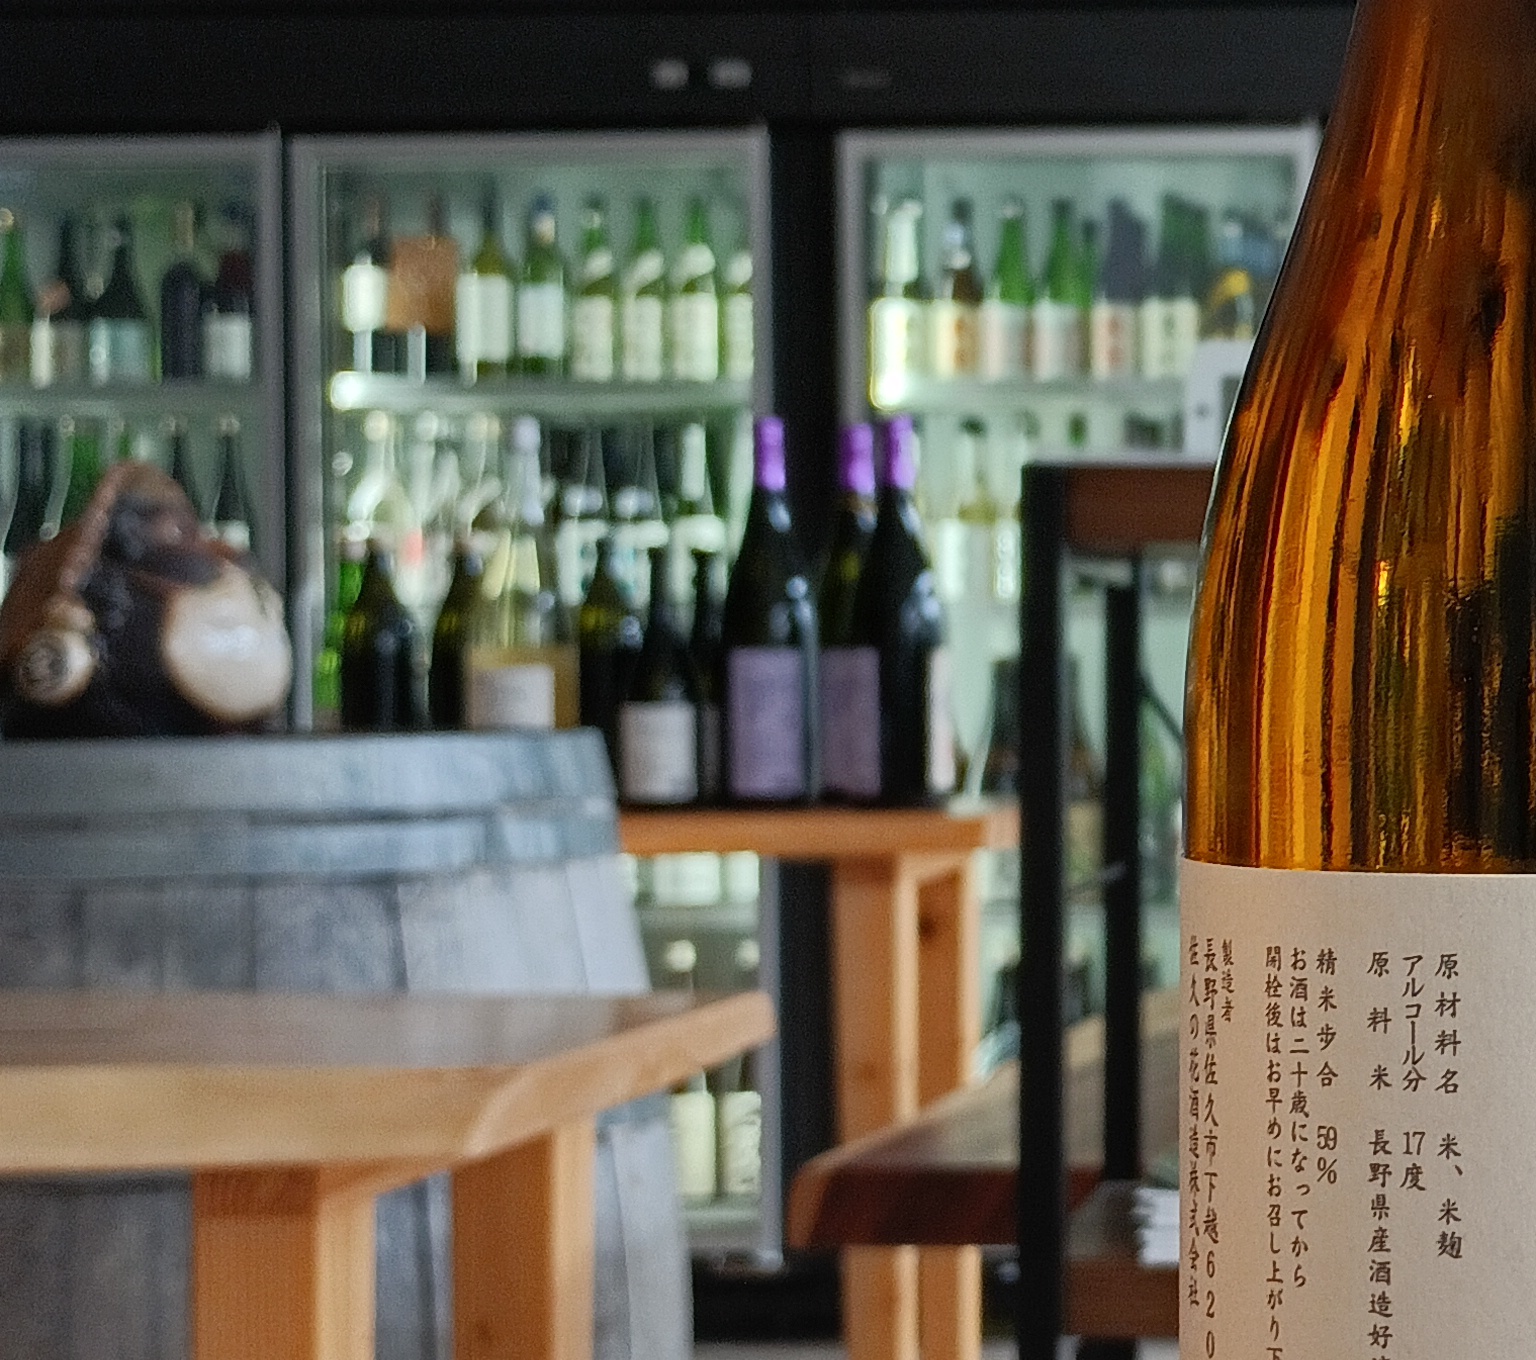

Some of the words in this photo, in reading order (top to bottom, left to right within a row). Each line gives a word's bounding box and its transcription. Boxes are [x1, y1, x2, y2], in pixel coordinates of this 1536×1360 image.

[1221, 939, 1235, 1023] 製造者
[1315, 947, 1339, 1088] 精米歩合
[1401, 954, 1427, 1093] アルコール分
[1434, 953, 1462, 1094] 原材料名
[1289, 947, 1311, 1288] お酒は二十歳になってから
[1399, 1131, 1426, 1192] 17度
